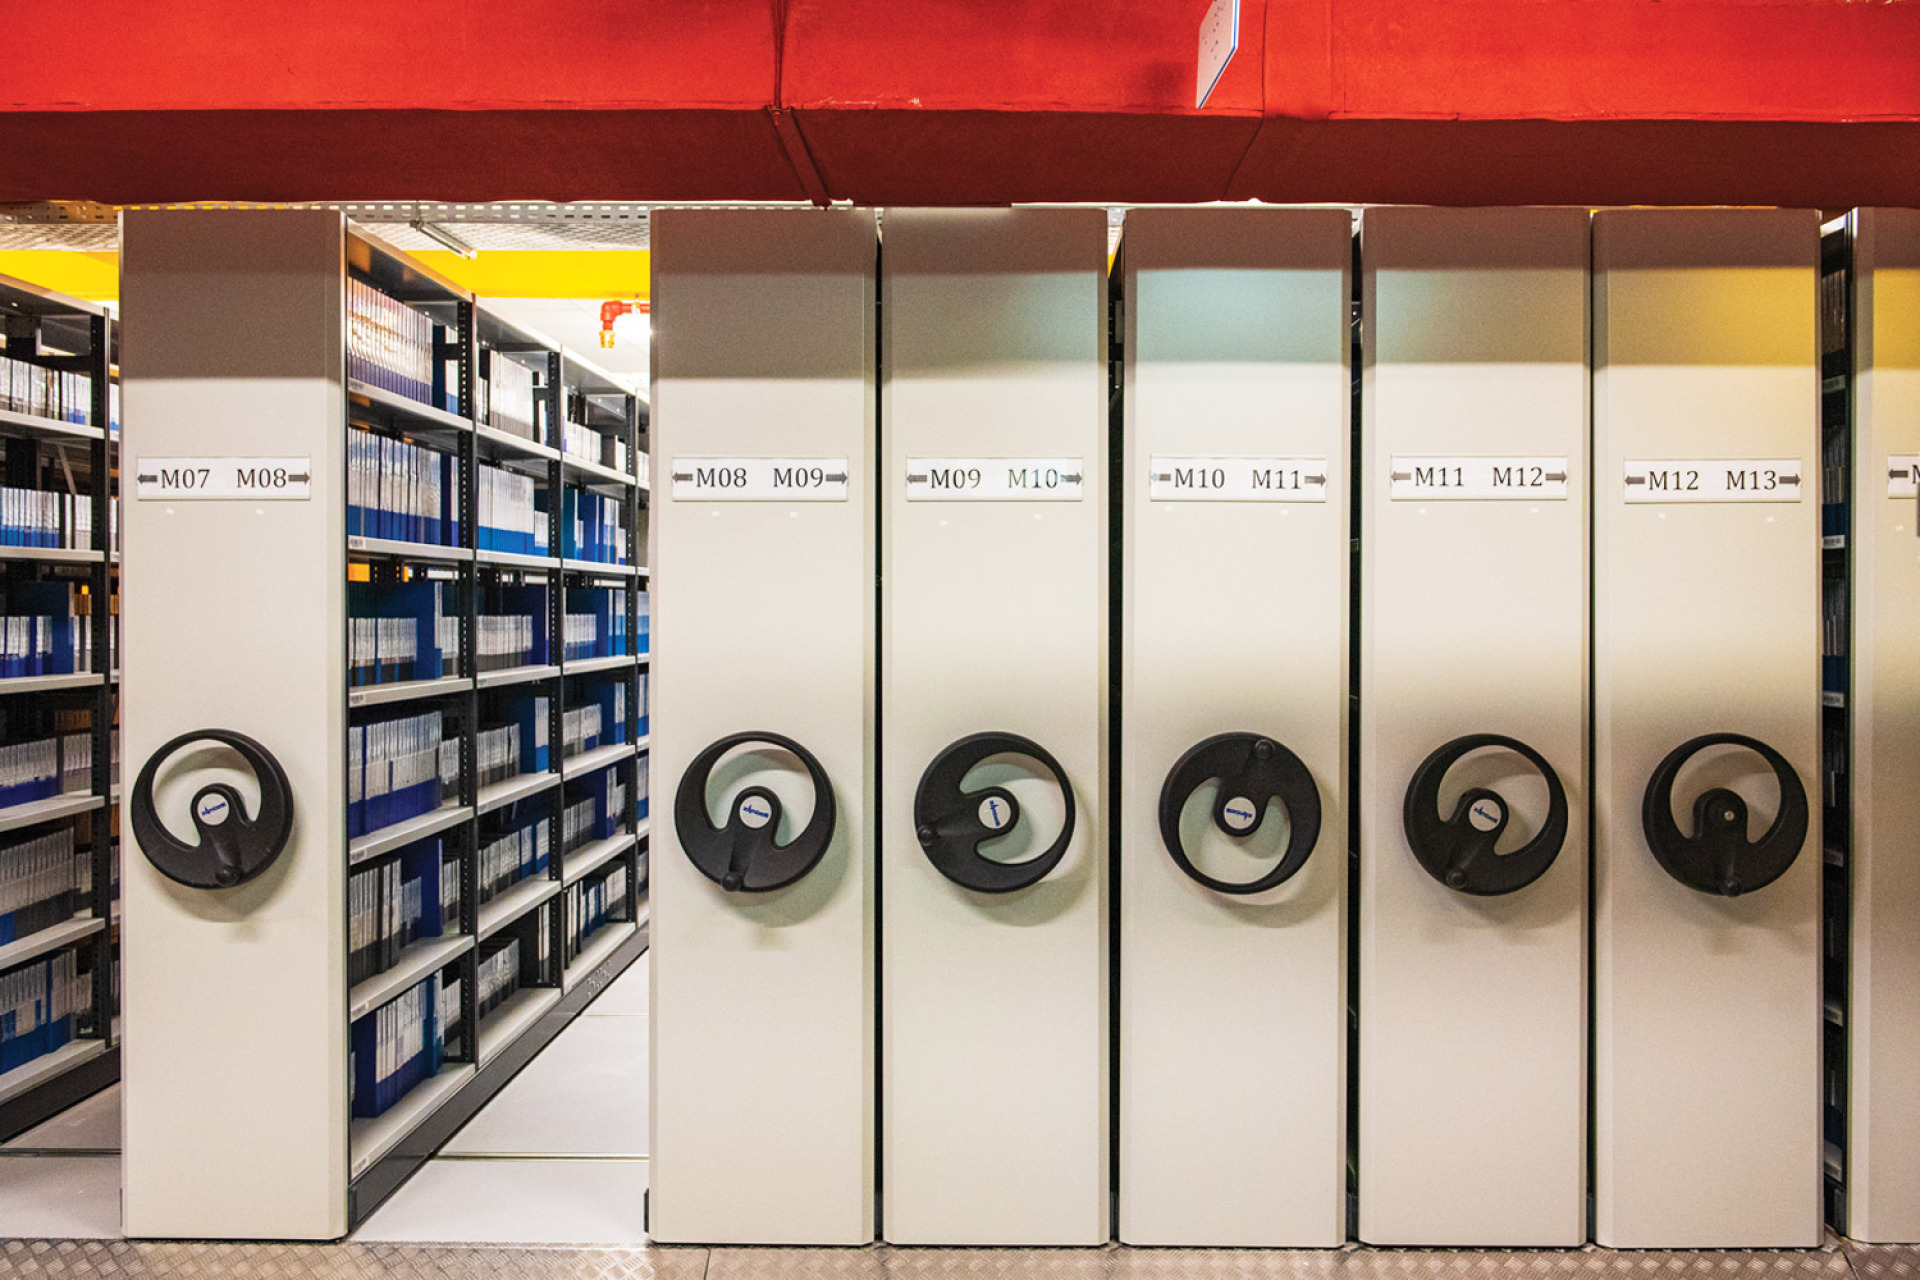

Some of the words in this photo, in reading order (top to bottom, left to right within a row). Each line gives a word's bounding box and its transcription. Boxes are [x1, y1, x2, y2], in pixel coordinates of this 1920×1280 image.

[160, 468, 211, 489] M07
[236, 468, 287, 489] M08
[696, 467, 747, 488] M08
[772, 467, 824, 488] M09
[930, 468, 981, 489] M09
[1007, 468, 1058, 489] M10
[1174, 468, 1225, 489] M10
[1251, 468, 1300, 490] M11
[1414, 466, 1464, 488] M11
[1492, 466, 1543, 488] M12
[1648, 469, 1699, 491] M12
[1725, 470, 1777, 491] M13
